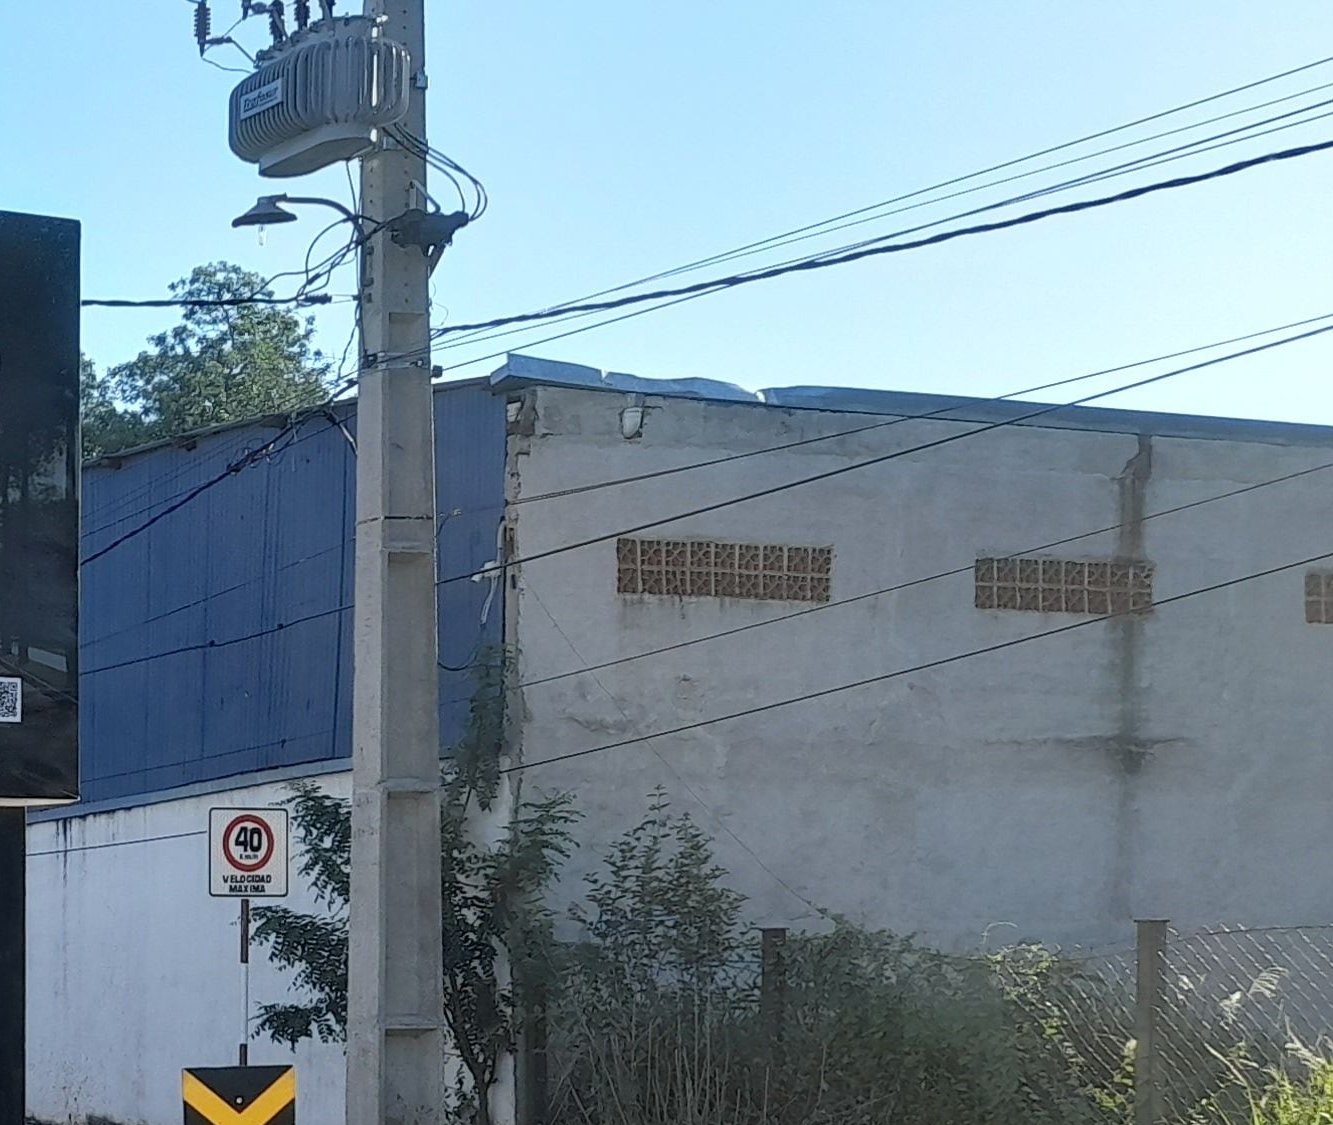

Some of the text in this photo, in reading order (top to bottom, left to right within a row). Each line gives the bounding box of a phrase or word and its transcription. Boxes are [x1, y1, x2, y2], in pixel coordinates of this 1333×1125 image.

[235, 826, 263, 852] 40
[222, 874, 272, 883] VELOCIDAD
[229, 884, 266, 893] MAXIMA
